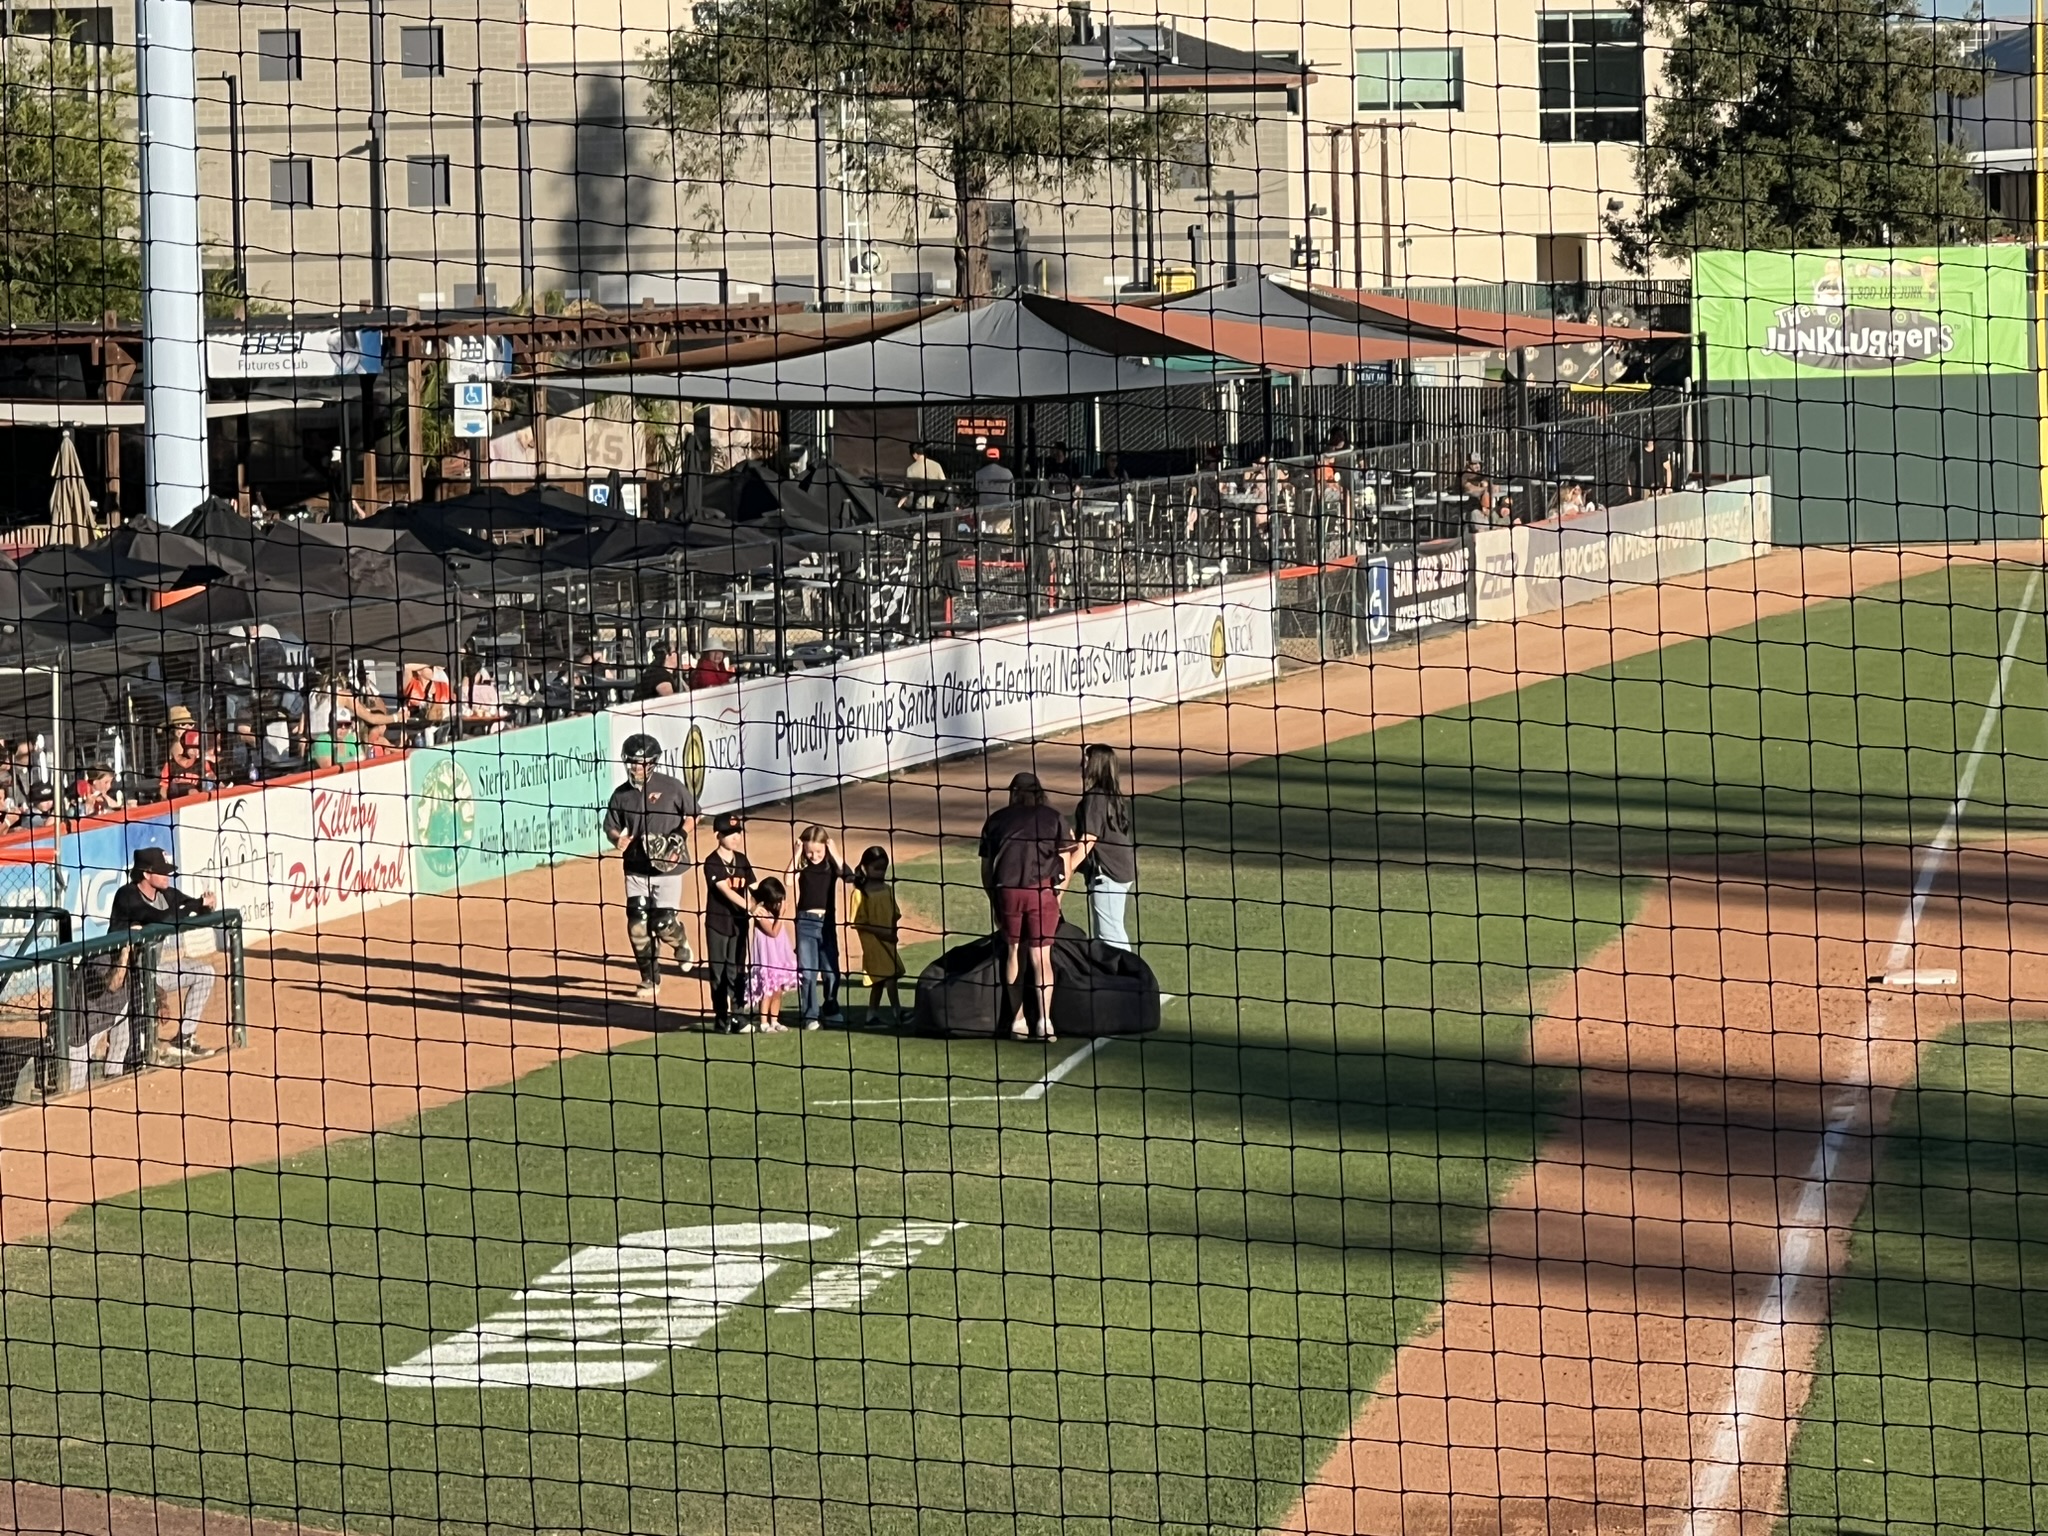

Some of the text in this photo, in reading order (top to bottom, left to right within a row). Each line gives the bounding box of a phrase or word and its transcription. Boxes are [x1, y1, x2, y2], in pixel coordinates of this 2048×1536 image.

[238, 358, 308, 370] Futures Cub
[1394, 559, 1413, 598] SAN
[775, 701, 831, 761] Poudly
[837, 690, 895, 745] Serving
[898, 680, 937, 730] Santa
[995, 649, 1057, 706] Electrical
[1060, 647, 1101, 693] Needs
[1140, 629, 1169, 676] 1912
[478, 741, 607, 797] Sierra Pacific Turf Suply
[313, 788, 377, 842] Killroy
[288, 840, 406, 919] Pest Control
